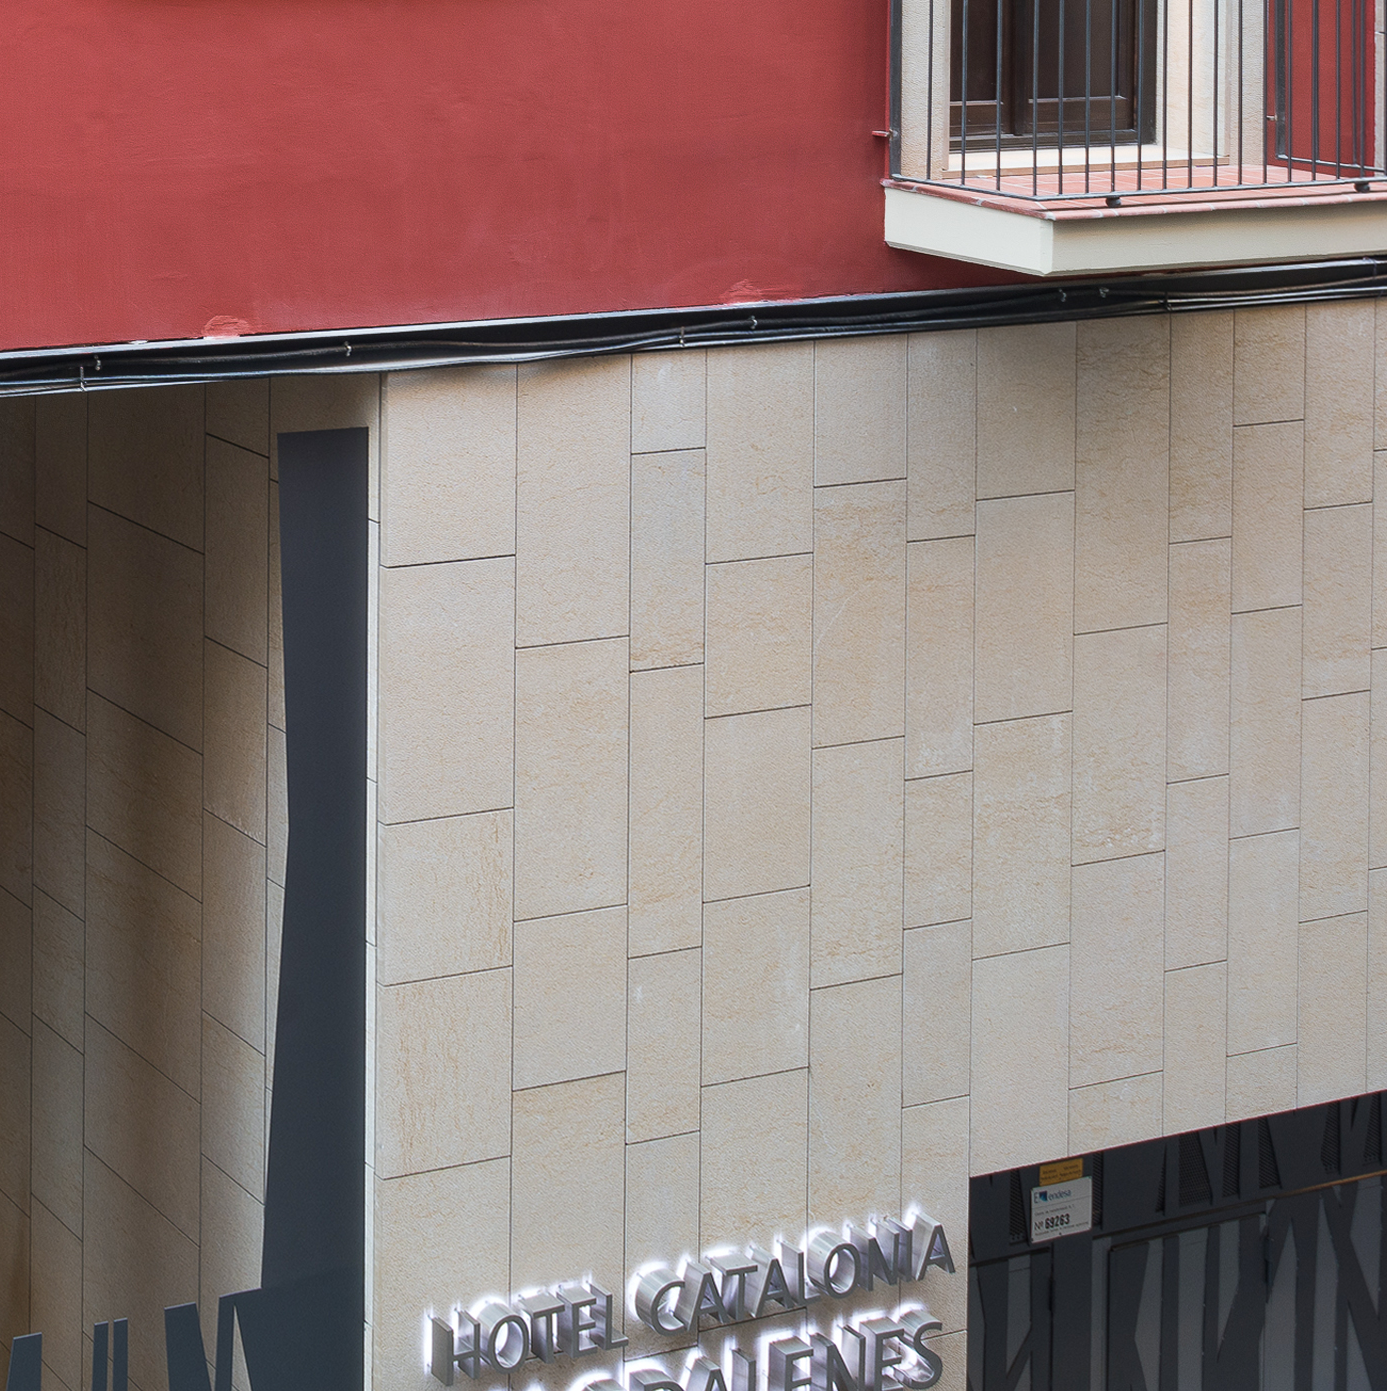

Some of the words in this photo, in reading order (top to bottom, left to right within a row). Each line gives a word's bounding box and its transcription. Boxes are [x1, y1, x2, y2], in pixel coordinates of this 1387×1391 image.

[1048, 1189, 1072, 1201] endesa
[1045, 1213, 1070, 1230] 69263
[431, 1282, 628, 1386] HOTEL
[635, 1211, 956, 1336] CATALONIA
